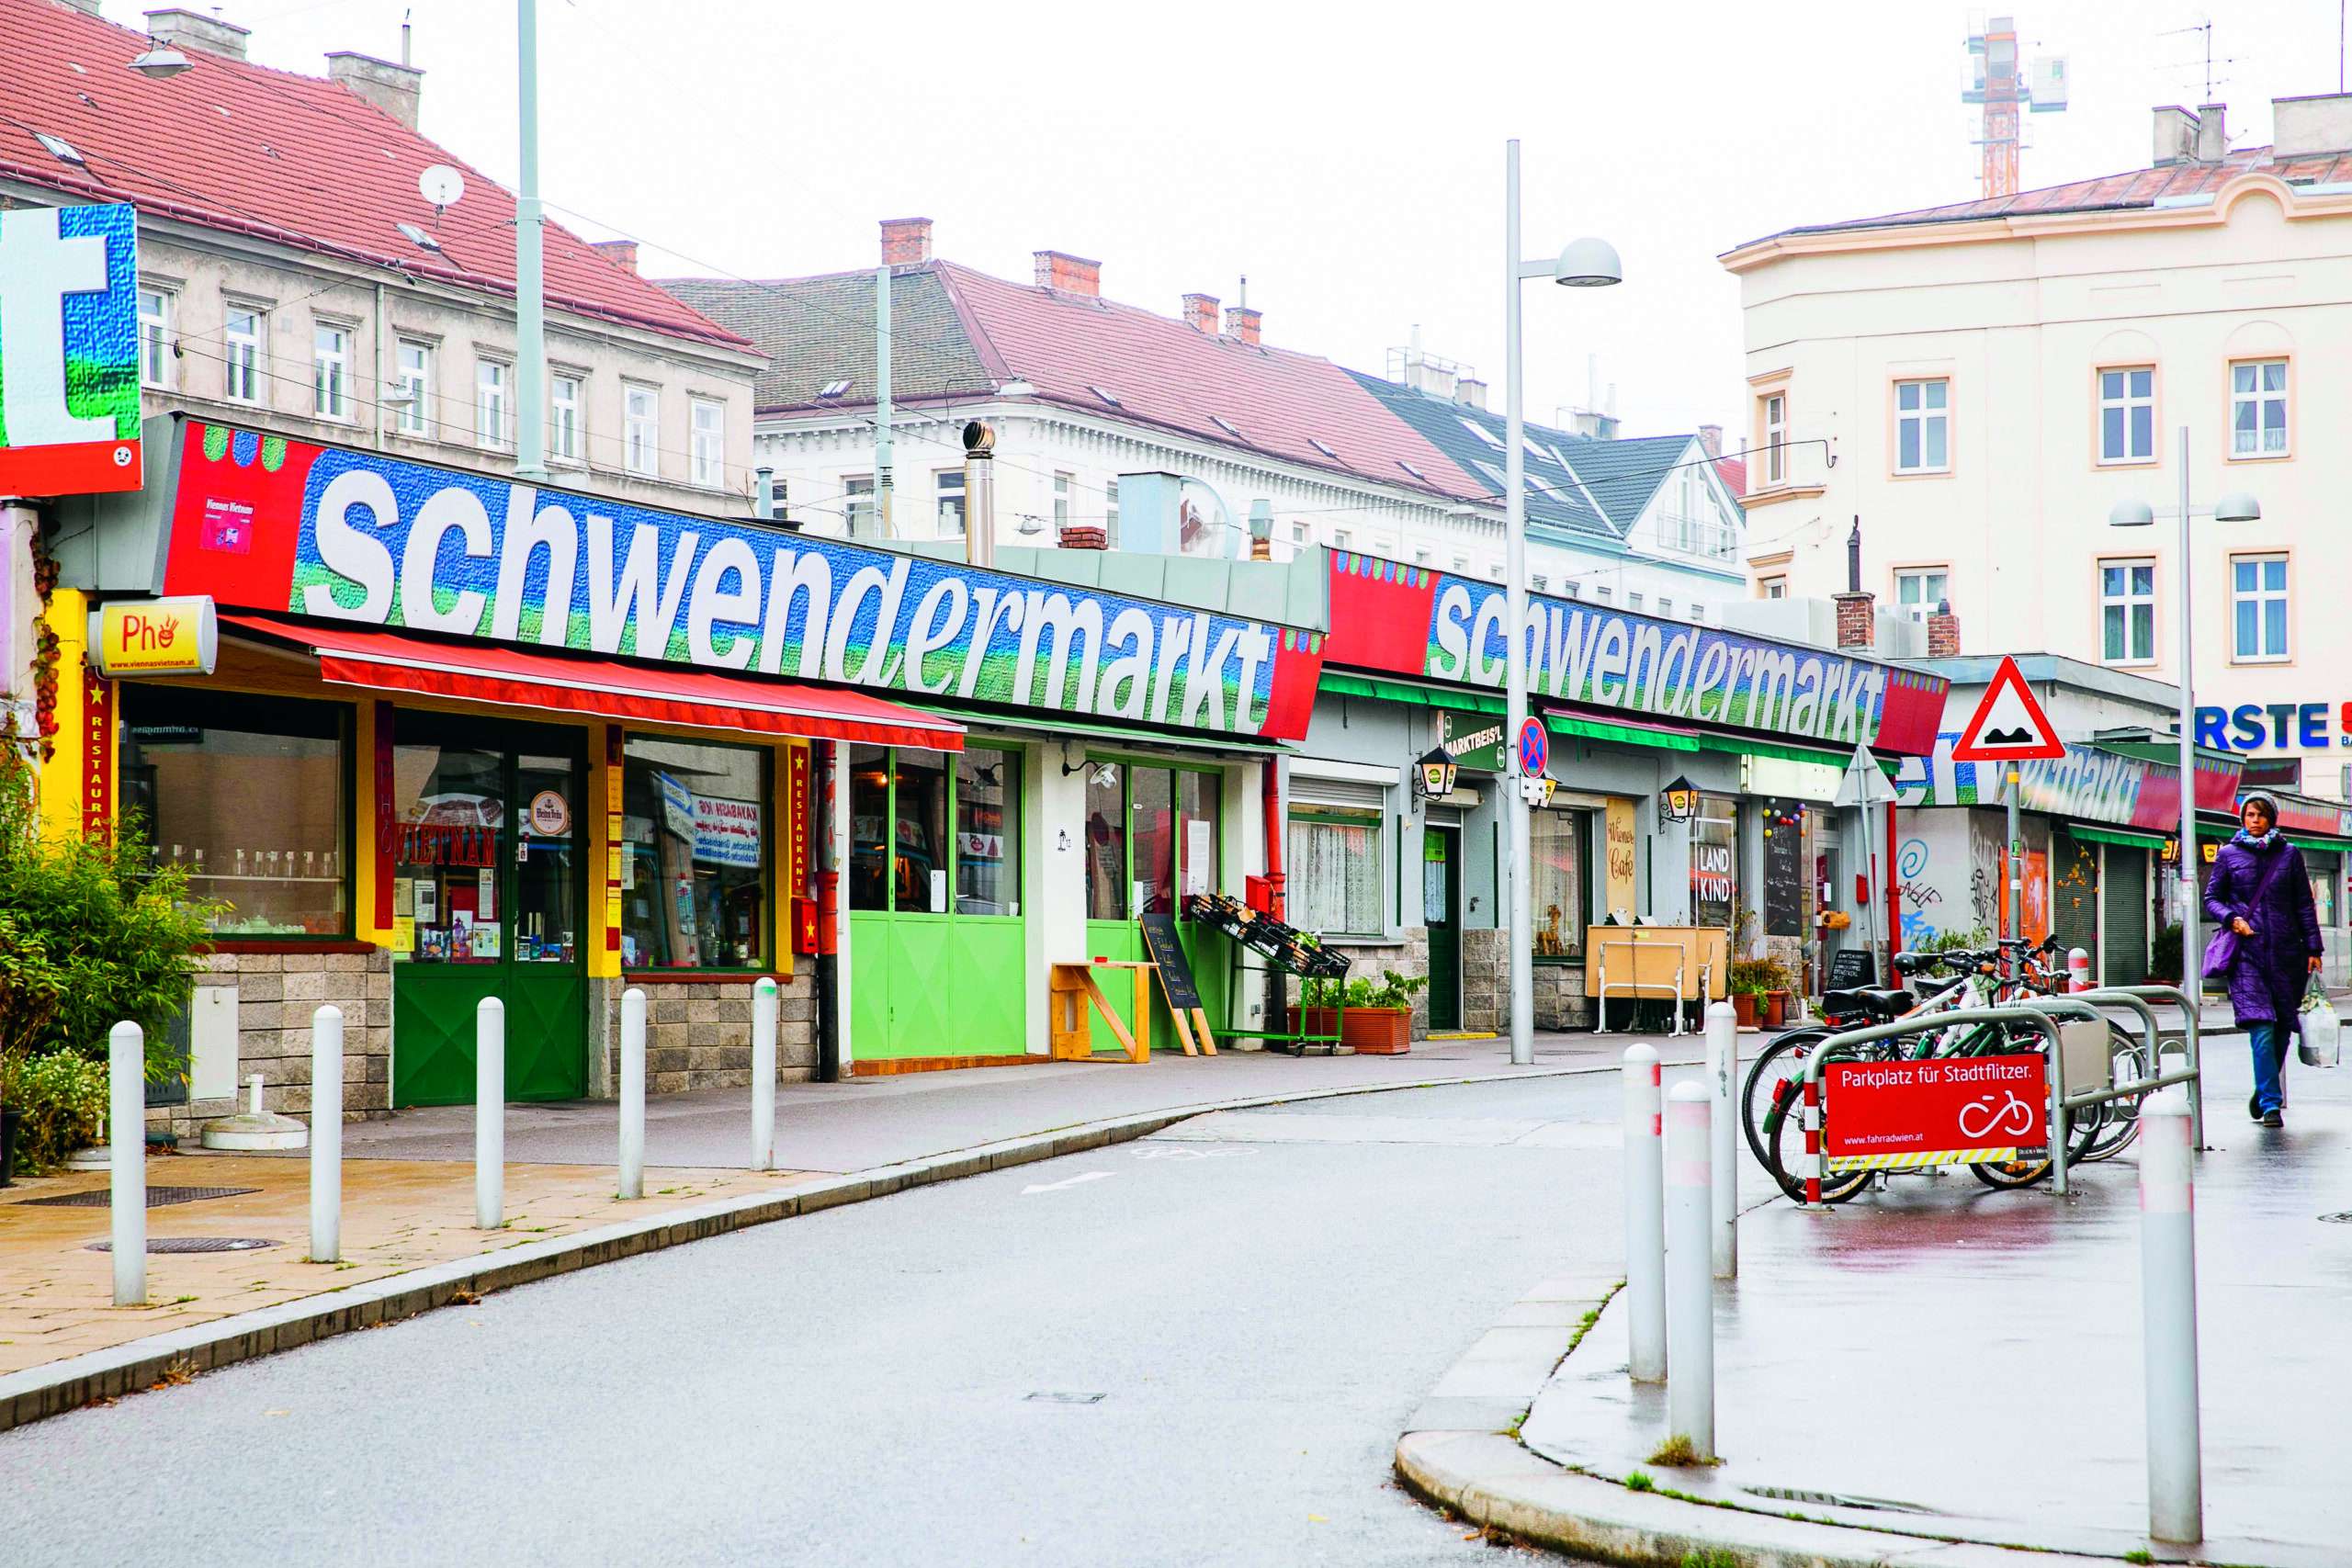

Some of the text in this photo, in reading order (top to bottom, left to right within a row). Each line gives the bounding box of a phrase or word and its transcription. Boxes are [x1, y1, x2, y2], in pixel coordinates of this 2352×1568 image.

[206, 498, 254, 515] Viennas Vietnam
[303, 469, 1270, 734] schwendermarkt
[110, 660, 196, 669] www.viennasvietnam.at
[2170, 704, 2330, 750] RSTE
[1444, 725, 1504, 757] MARKTBEIS'L
[796, 779, 804, 886] RESTAURANT
[1608, 817, 1634, 844] Wiener
[395, 822, 496, 867] VIETNAM
[1700, 847, 1729, 873] LAND
[1700, 877, 1730, 902] KIND
[1842, 1064, 2032, 1089] Parkplatz für Stadtflitzer.
[1844, 1133, 1924, 1145] www.fahrradwien.at
